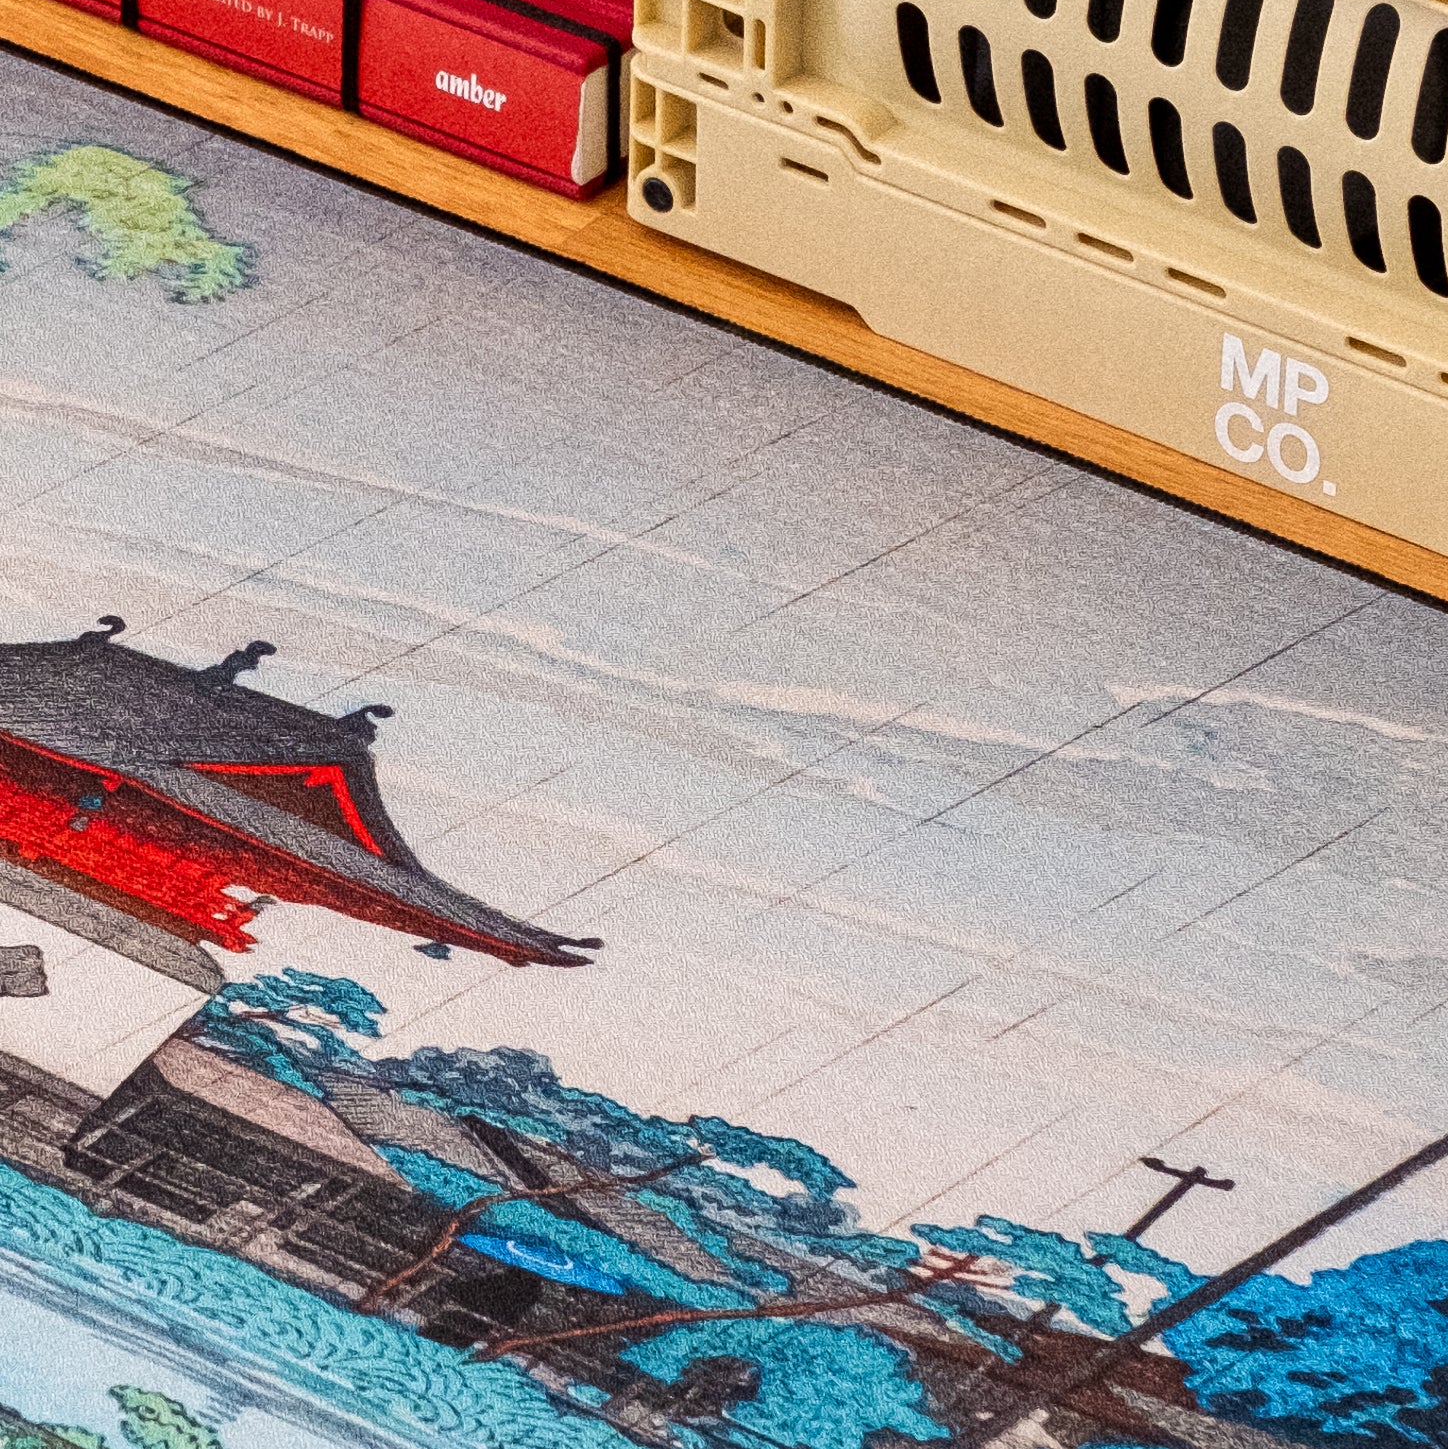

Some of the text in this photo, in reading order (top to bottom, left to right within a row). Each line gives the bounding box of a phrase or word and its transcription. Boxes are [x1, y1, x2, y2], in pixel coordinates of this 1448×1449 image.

[257, 5, 274, 21] BY
[435, 70, 507, 112] amber
[1220, 332, 1329, 416] MP
[1214, 401, 1337, 497] CO.
